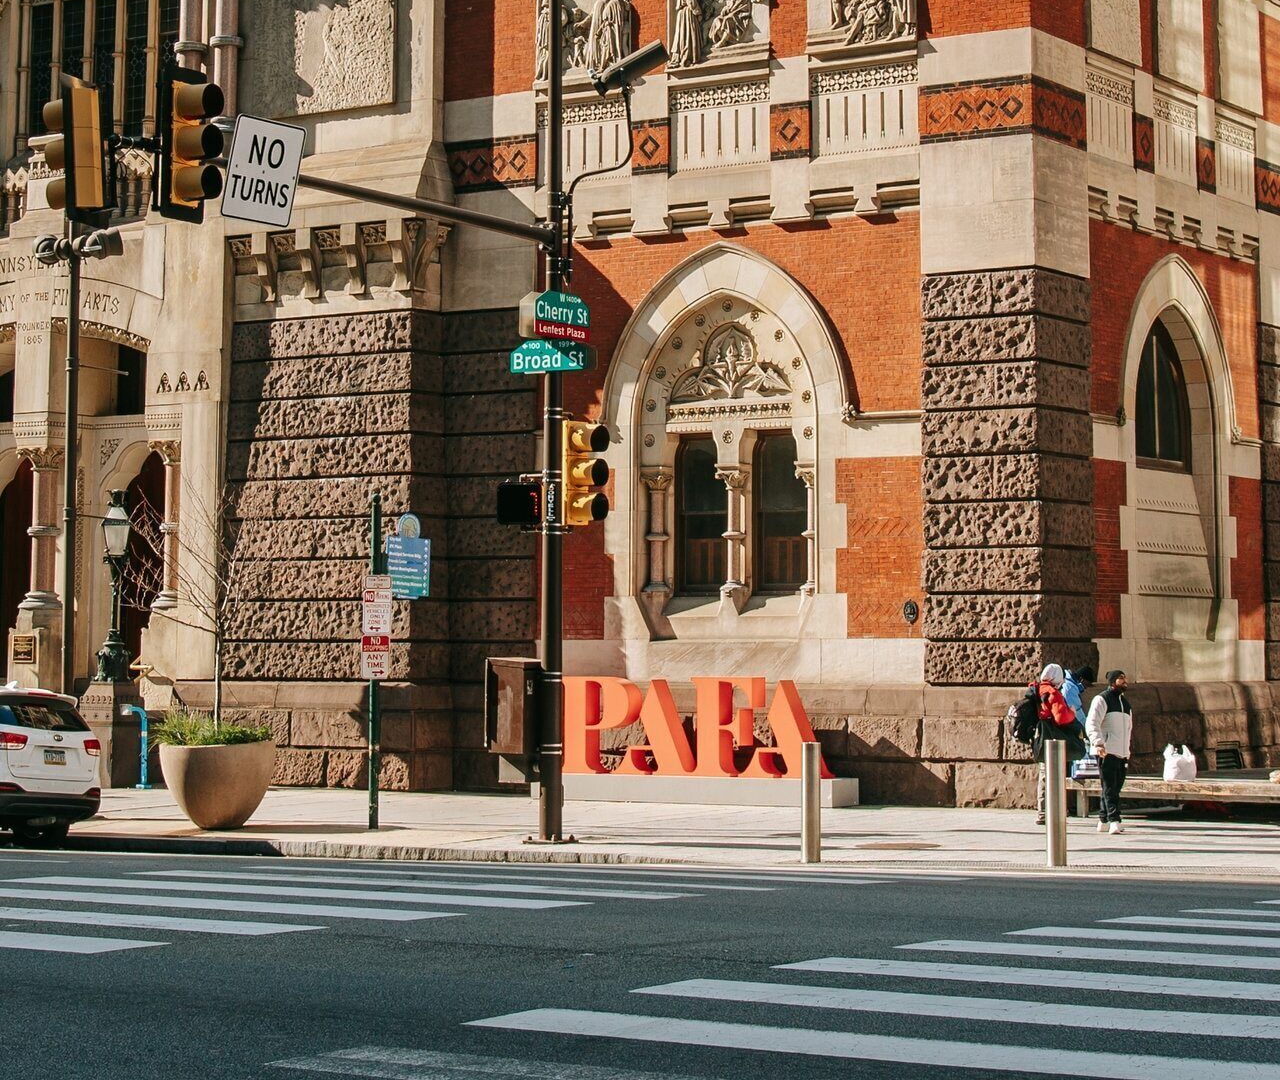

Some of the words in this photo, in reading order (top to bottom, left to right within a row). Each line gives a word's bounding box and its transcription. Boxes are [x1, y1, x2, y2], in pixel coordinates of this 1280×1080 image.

[248, 134, 285, 169] NO
[231, 173, 290, 208] TURNS
[20, 293, 31, 304] OF
[35, 291, 49, 302] THE
[83, 291, 120, 315] ARTS
[560, 293, 566, 302] W
[536, 300, 574, 325] Cherry
[577, 308, 588, 324] St
[17, 321, 51, 332] FOUNDED
[539, 323, 565, 336] Lenfest
[566, 327, 586, 339] Plaza
[24, 335, 43, 345] 1805
[545, 341, 552, 349] N
[513, 351, 561, 370] Broad
[568, 351, 584, 367] St
[365, 591, 374, 601] NO
[370, 636, 381, 645] NO
[363, 644, 389, 652] STOPPING
[562, 676, 837, 779] PAFA
